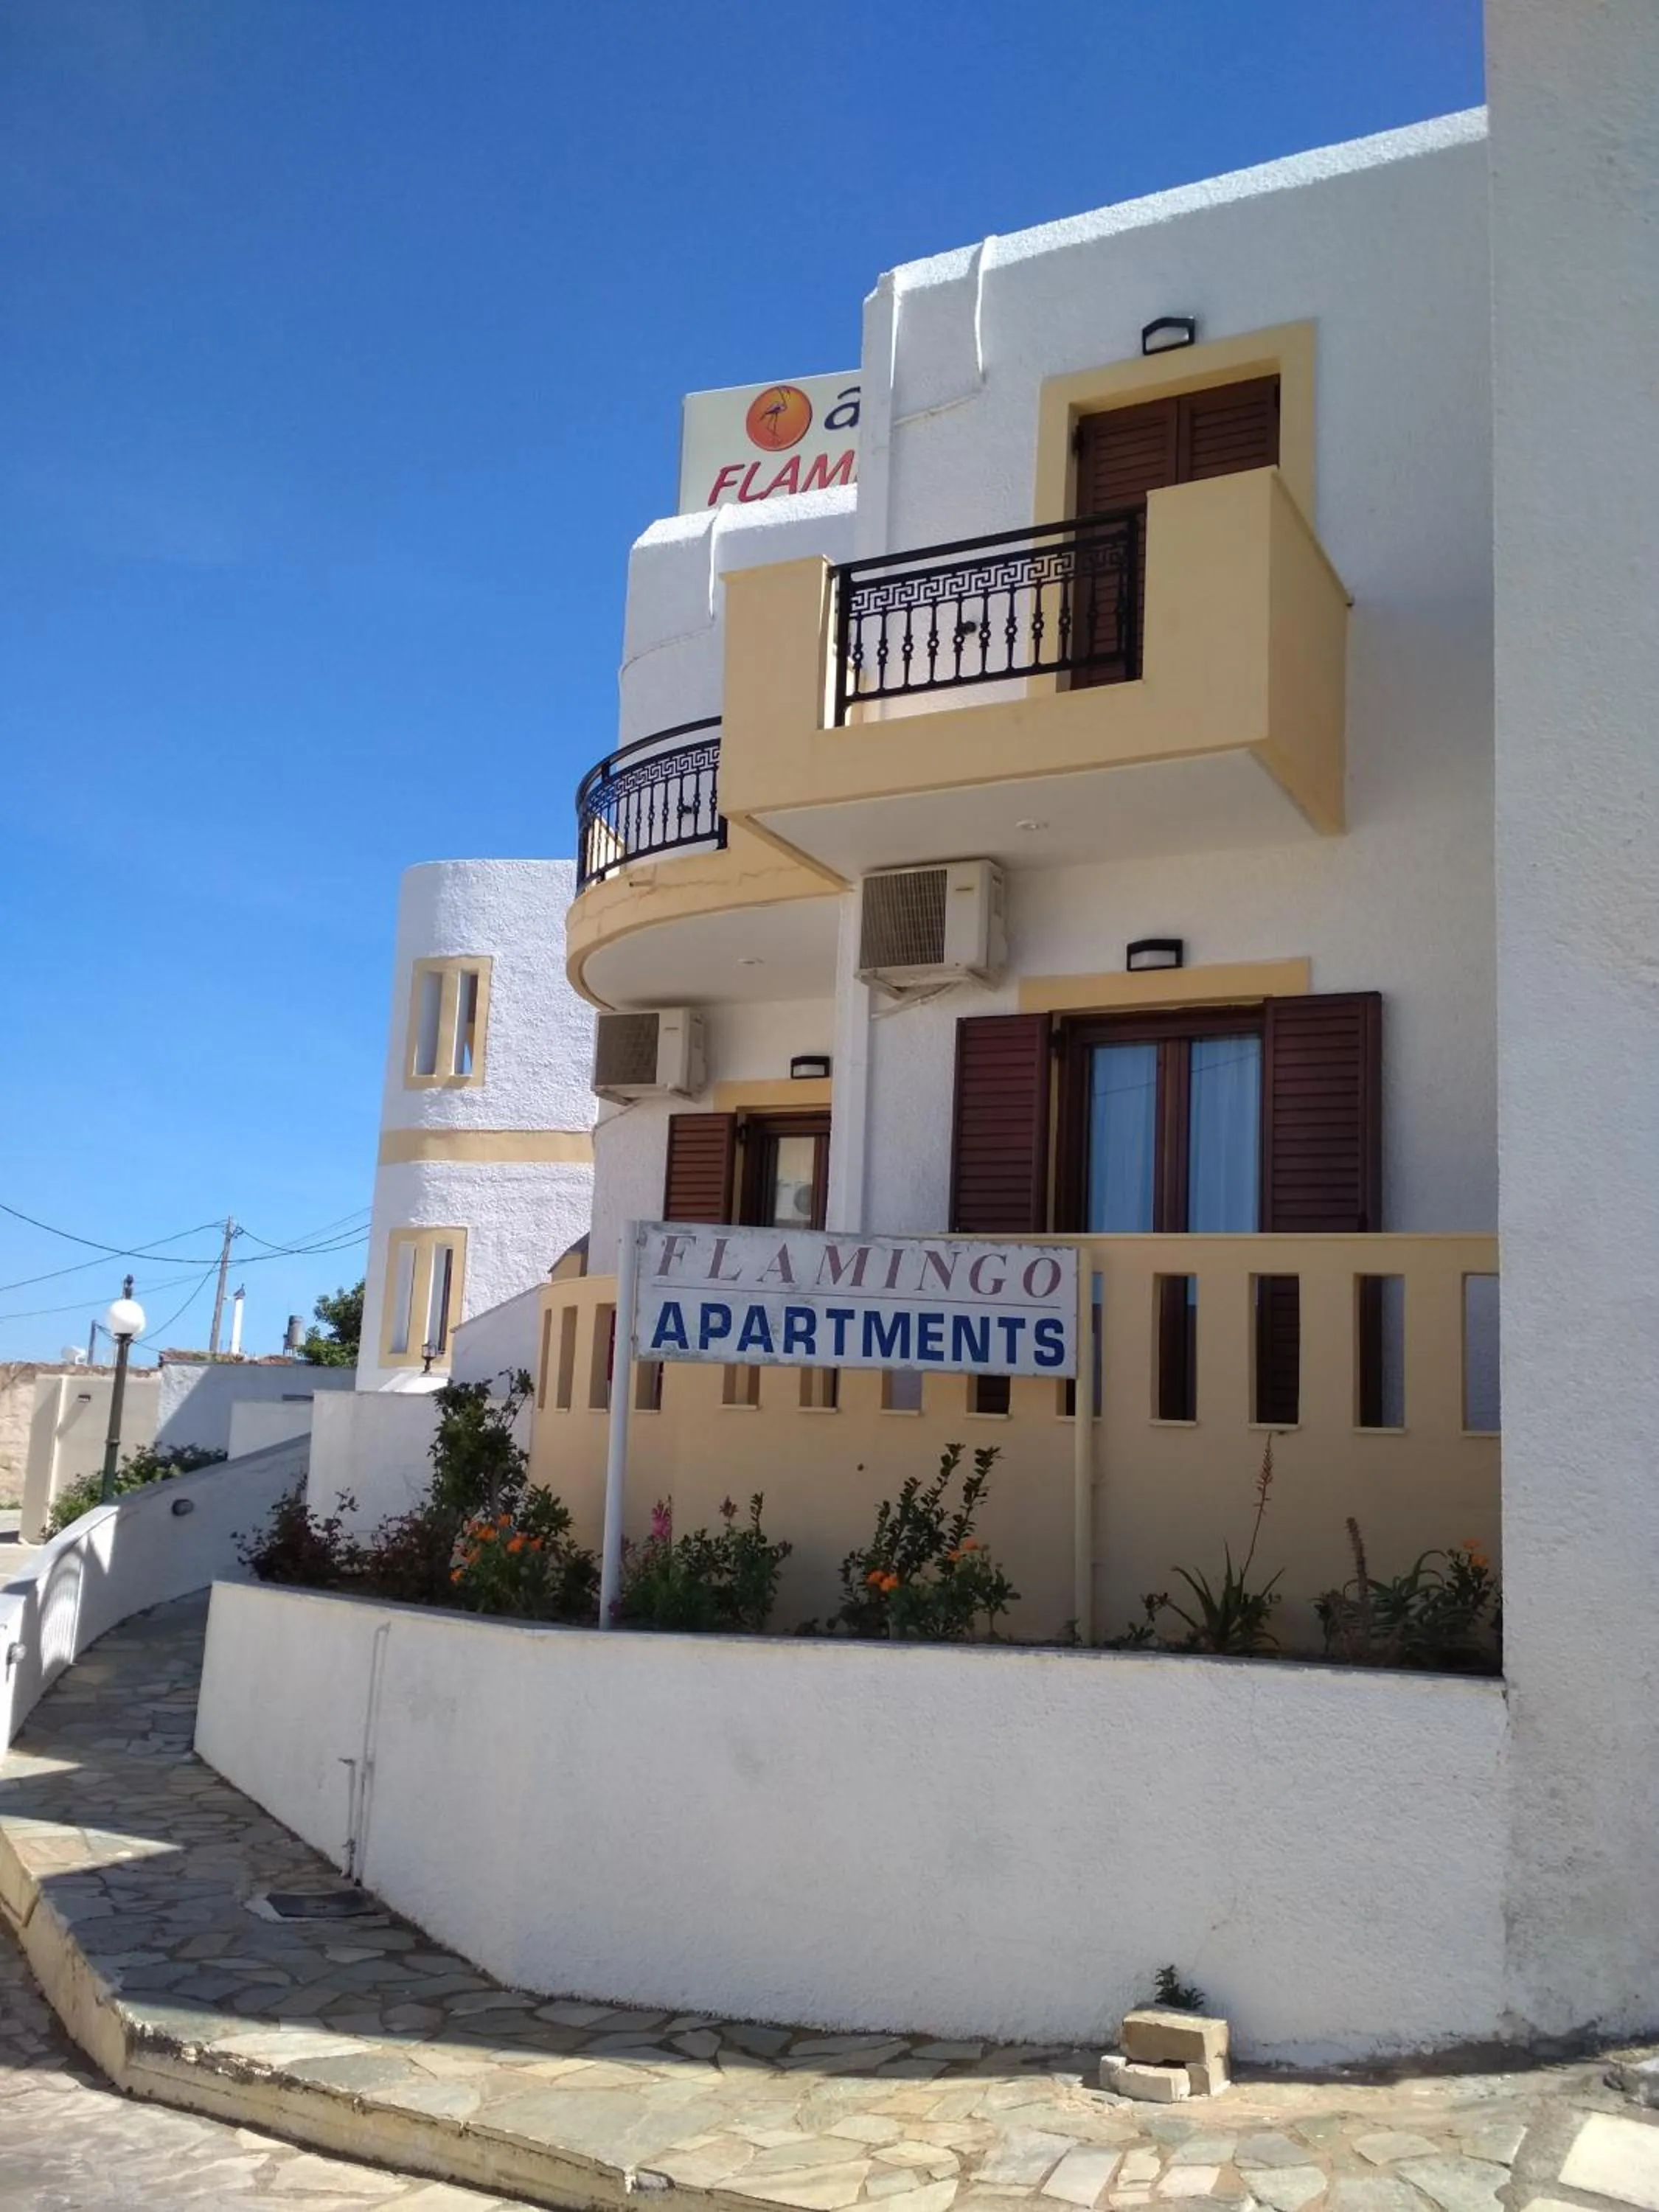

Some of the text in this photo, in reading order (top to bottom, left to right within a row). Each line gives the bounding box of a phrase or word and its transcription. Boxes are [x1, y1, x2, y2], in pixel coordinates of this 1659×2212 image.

[708, 449, 858, 507] FLAM
[655, 1234, 1062, 1298] FLAMINGO
[650, 1301, 1065, 1367] APARTMENTS
